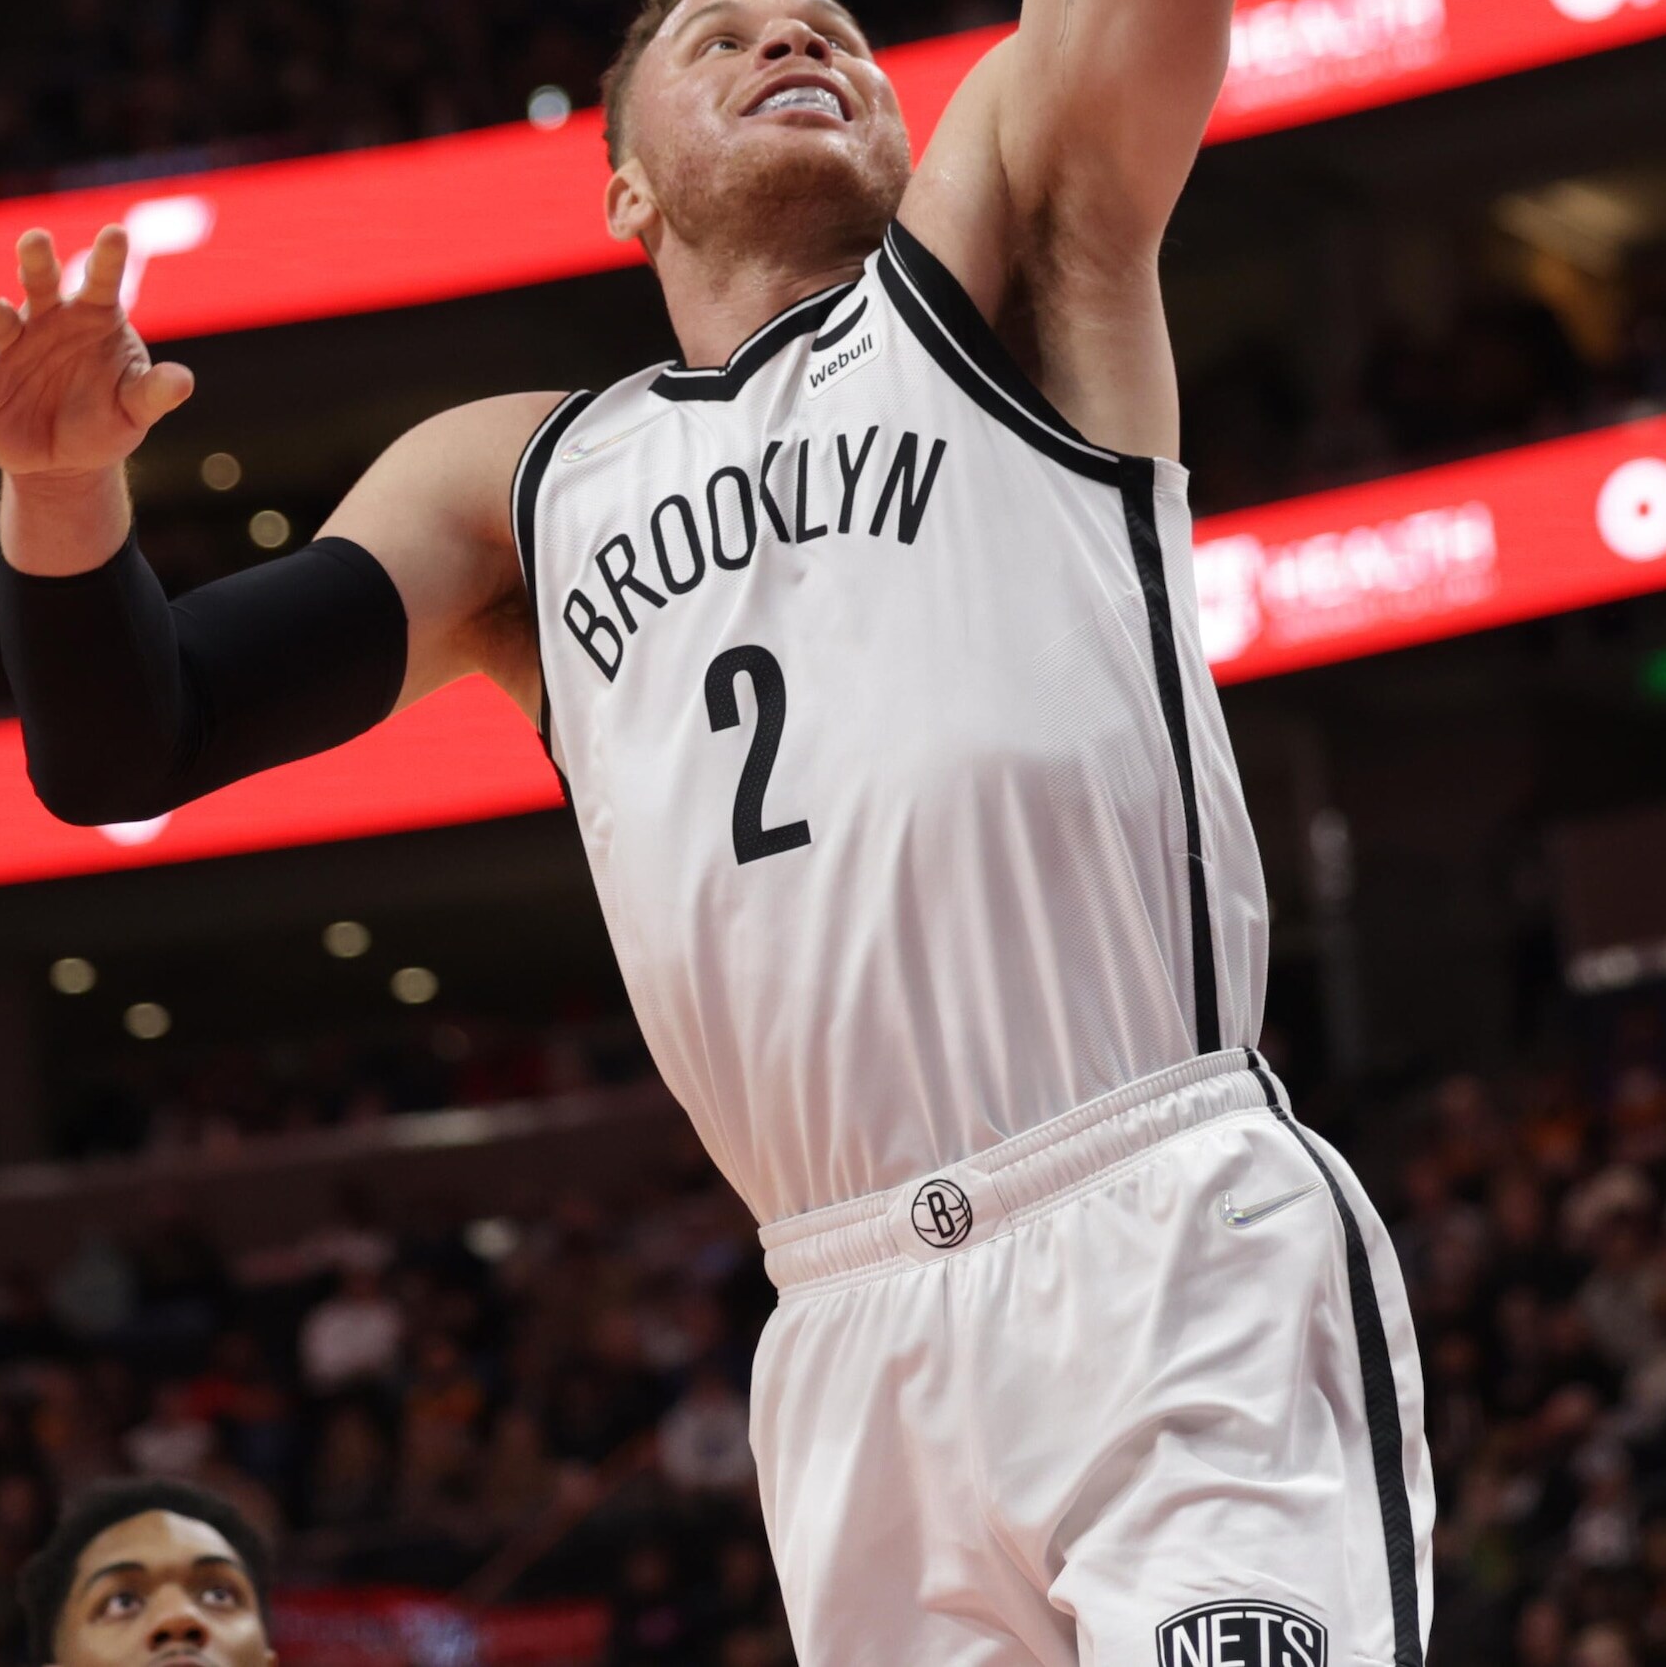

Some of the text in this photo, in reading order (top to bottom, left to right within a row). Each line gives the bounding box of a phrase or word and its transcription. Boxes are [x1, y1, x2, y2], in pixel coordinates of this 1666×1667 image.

[809, 333, 874, 390] Webull
[563, 424, 947, 684] BROOKLYN
[704, 644, 812, 866] 2
[1171, 1610, 1316, 1667] NETS
